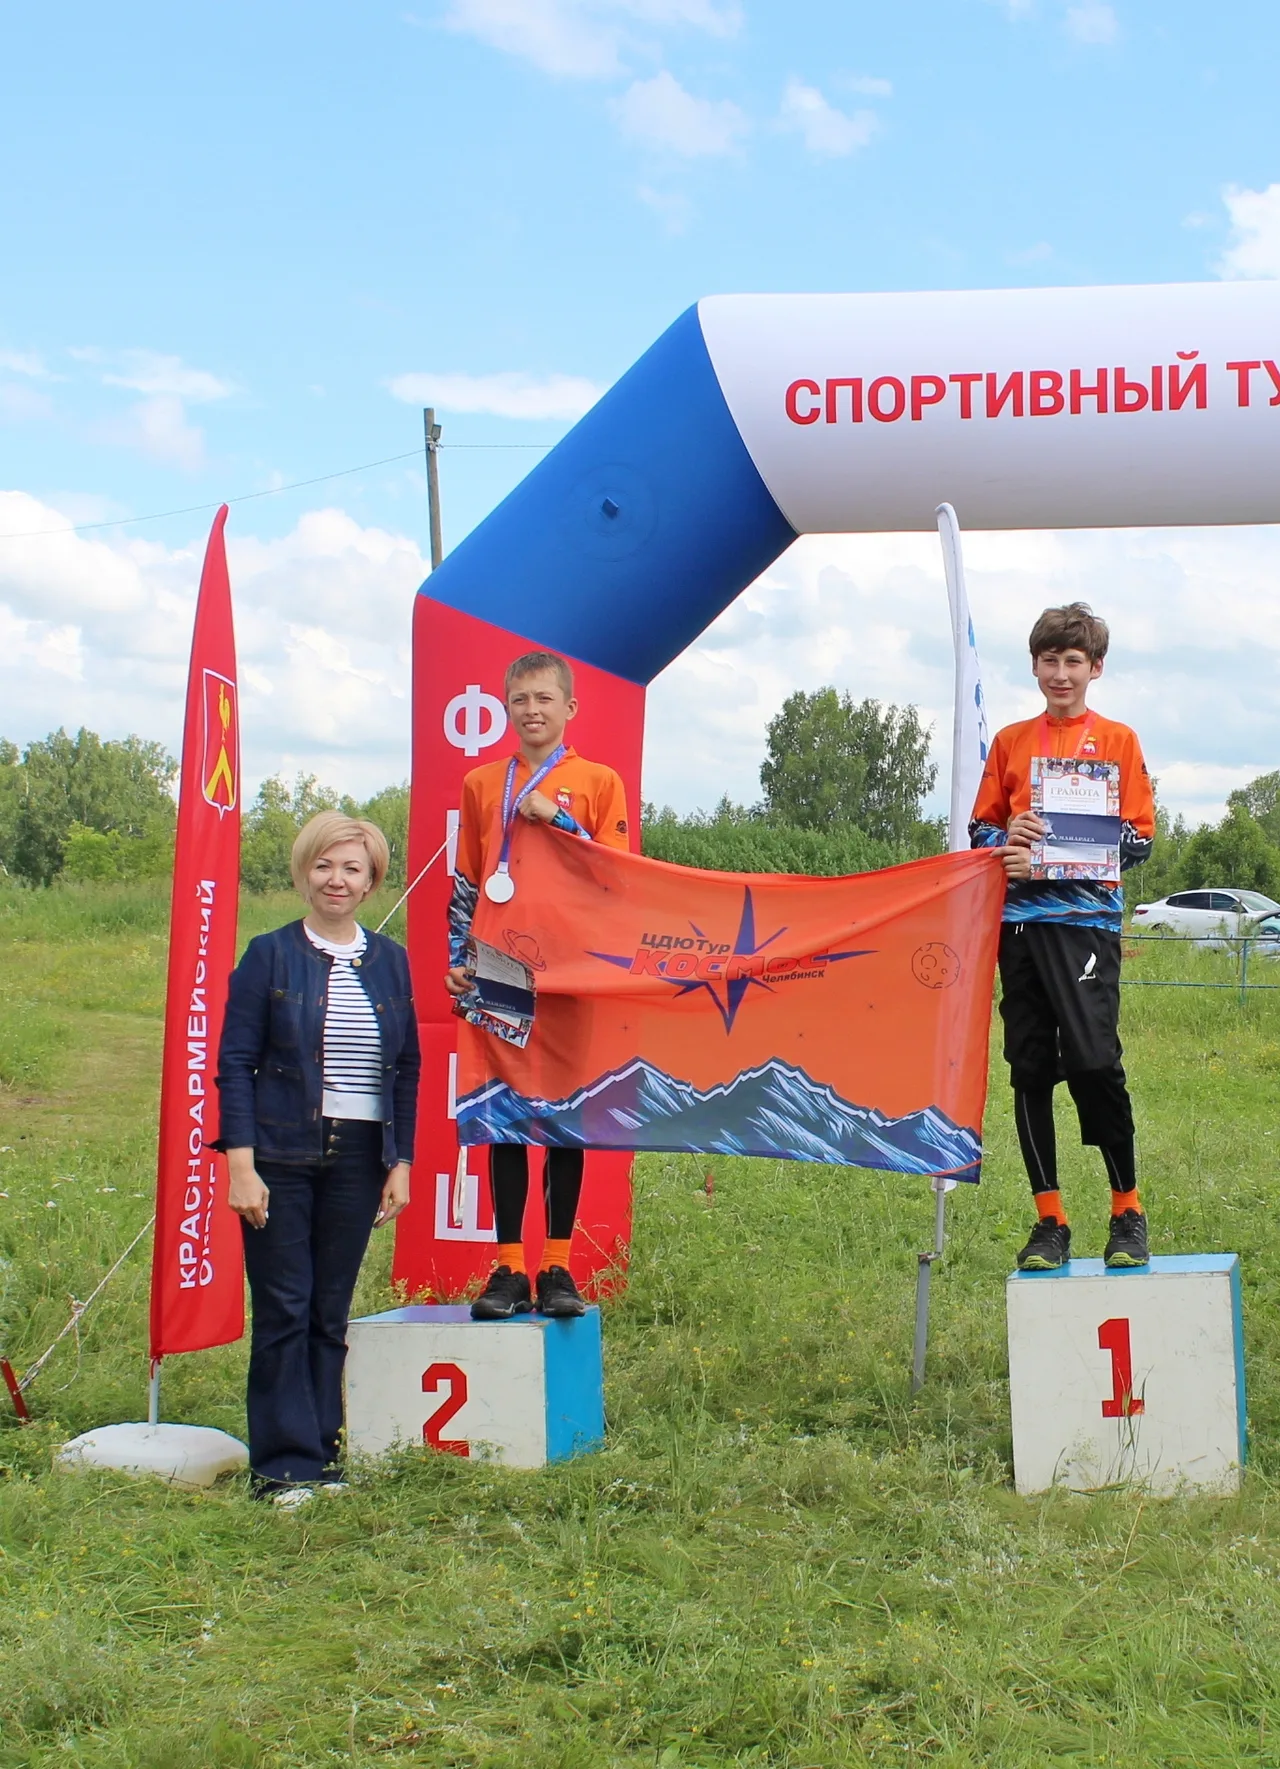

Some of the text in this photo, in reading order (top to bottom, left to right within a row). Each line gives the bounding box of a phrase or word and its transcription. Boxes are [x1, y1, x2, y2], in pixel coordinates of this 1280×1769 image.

[785, 351, 1208, 425] СПОРТИВНЫЙ
[1050, 787, 1100, 797] ГРАМОТА
[629, 948, 829, 981] КОСМОС
[762, 969, 825, 984] Челябинск
[180, 880, 216, 1289] КРАСНОАРМЕЙСКИЙ
[1097, 1318, 1145, 1418] 1
[421, 1362, 471, 1457] 2
